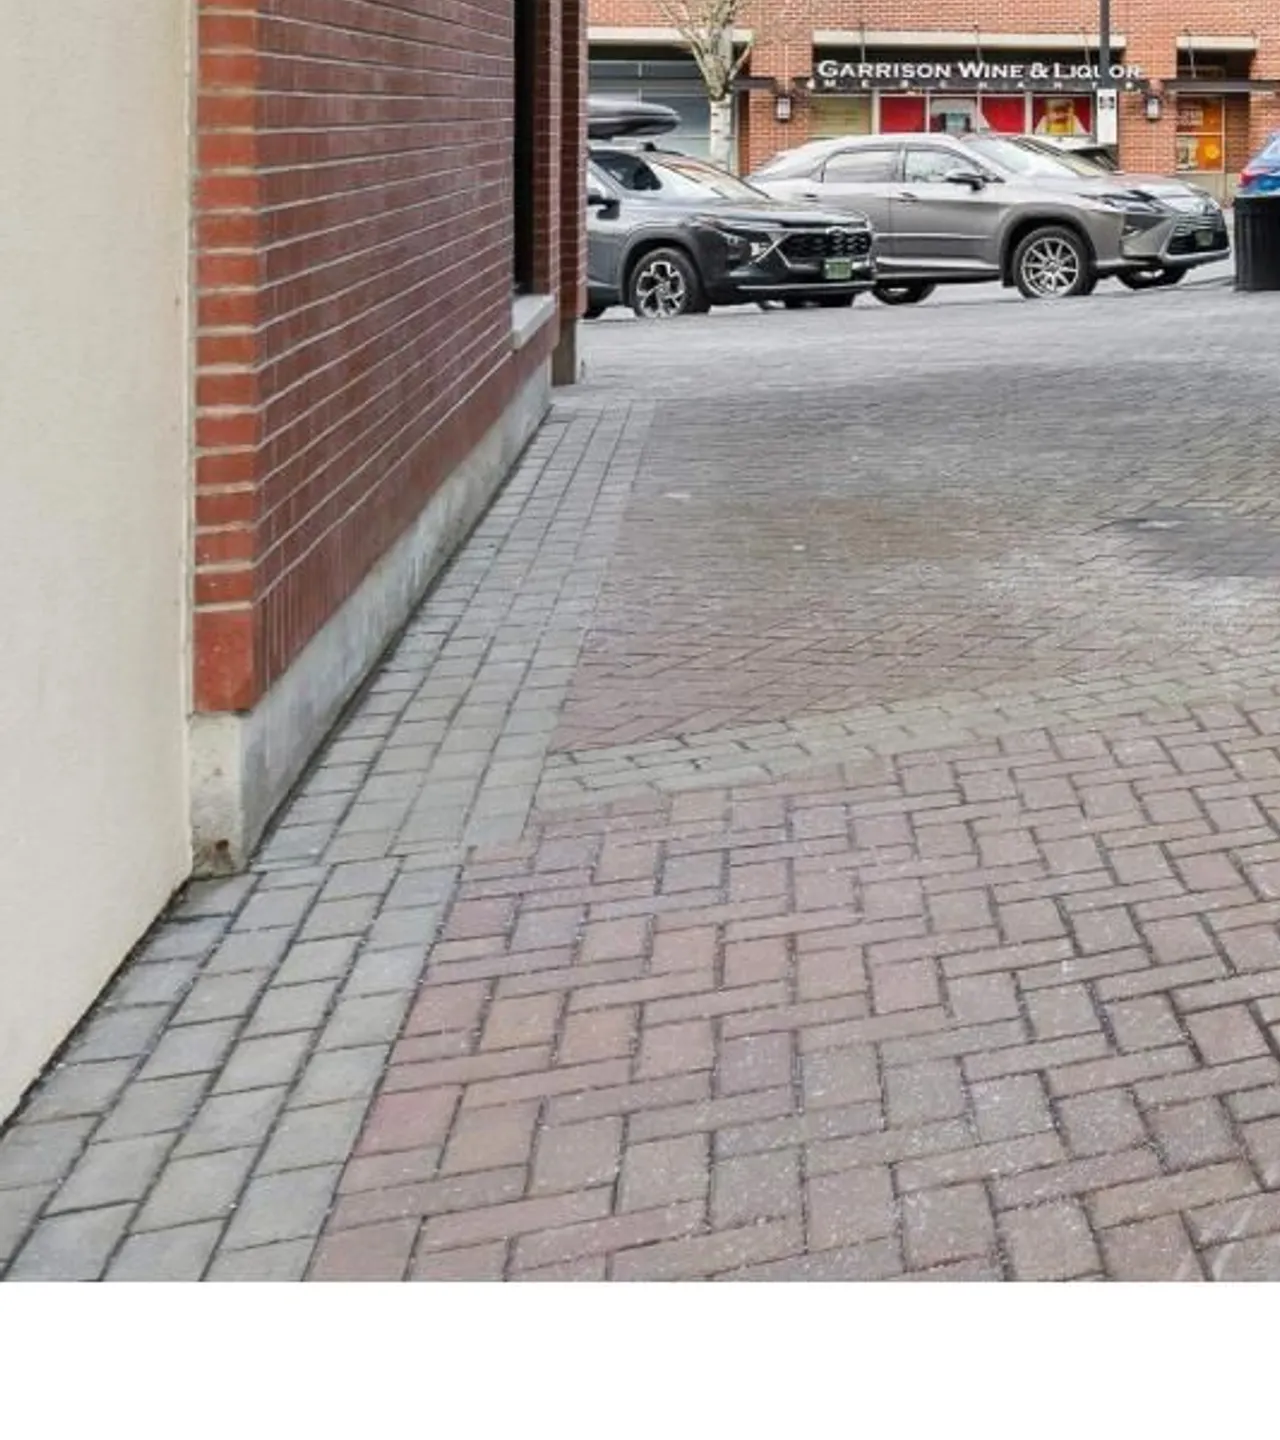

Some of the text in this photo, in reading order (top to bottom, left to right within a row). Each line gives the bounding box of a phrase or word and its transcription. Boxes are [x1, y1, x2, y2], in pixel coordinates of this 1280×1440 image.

[818, 59, 952, 78] GARRISON
[956, 60, 1024, 79] WINE
[1029, 62, 1051, 79] &
